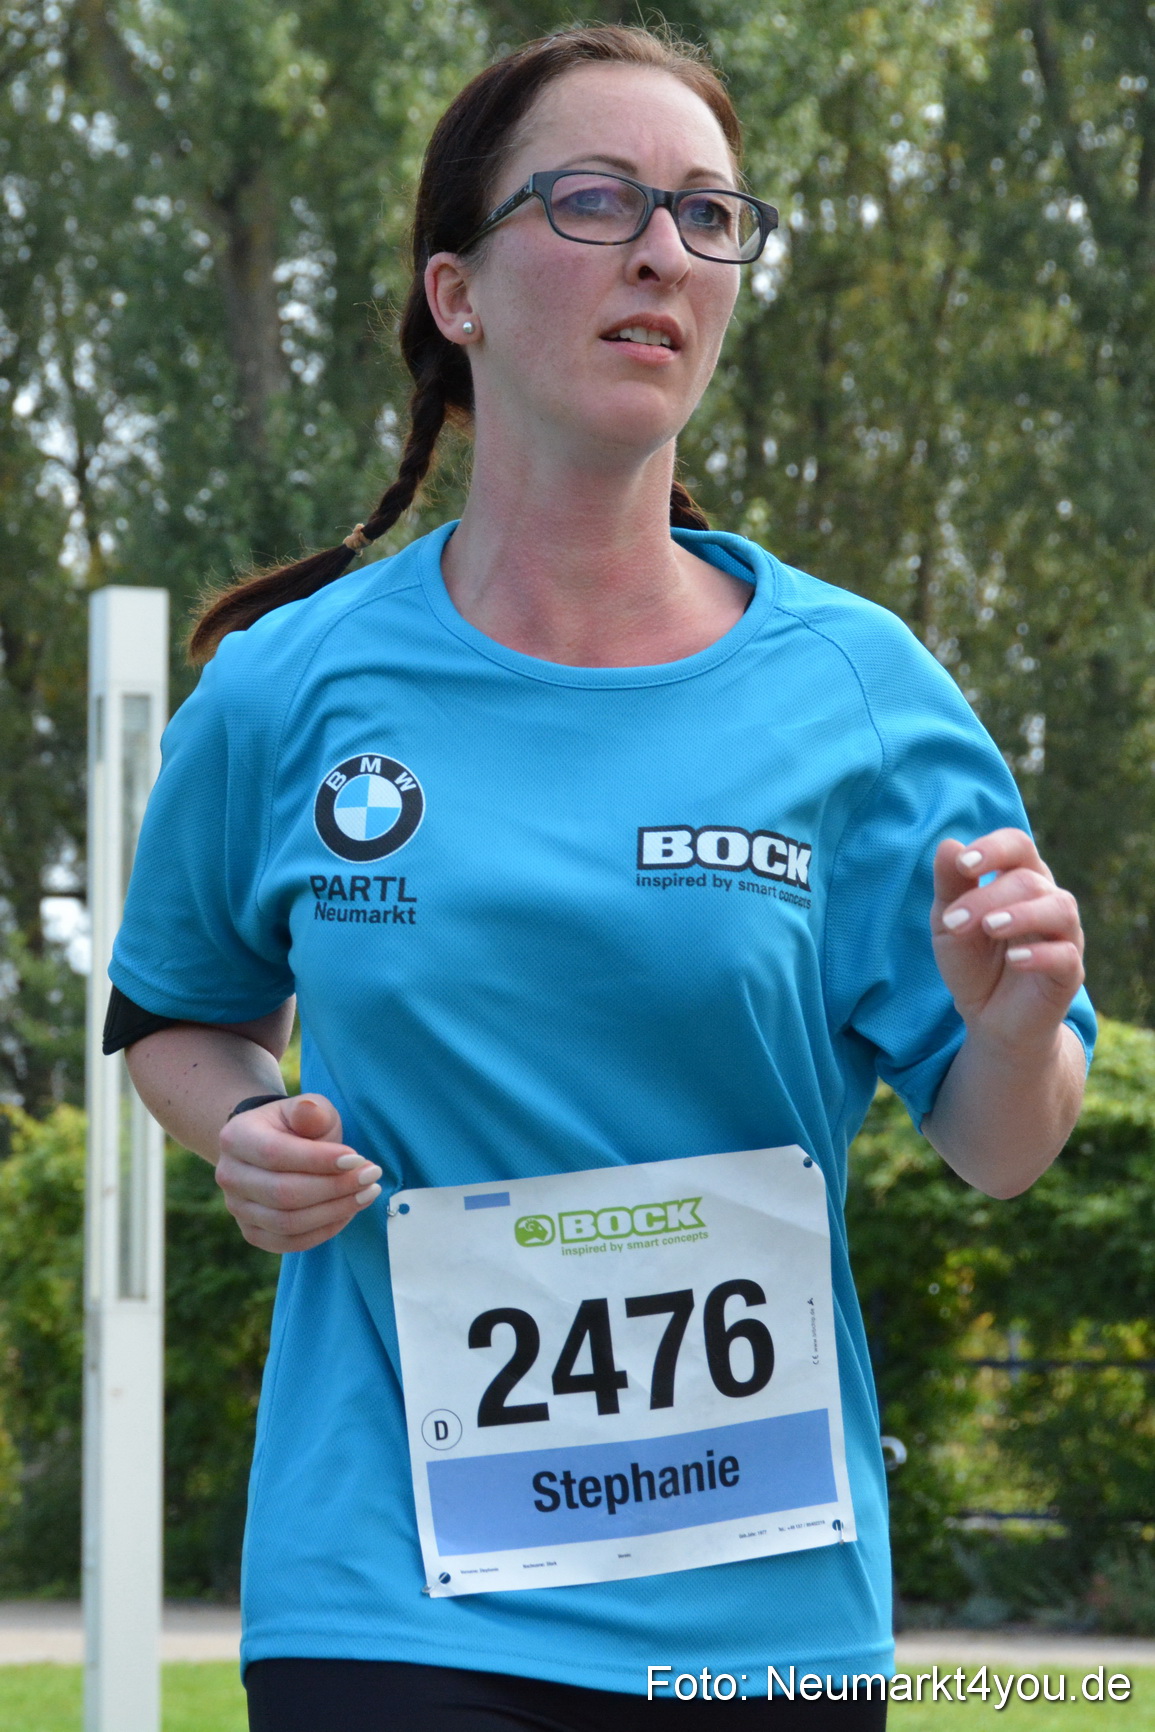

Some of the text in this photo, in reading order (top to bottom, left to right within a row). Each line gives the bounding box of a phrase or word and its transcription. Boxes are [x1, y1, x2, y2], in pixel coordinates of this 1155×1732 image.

[326, 757, 416, 791] BMW
[637, 825, 812, 892] BOCK
[310, 875, 417, 902] PARTL
[636, 872, 707, 890] inspired
[713, 875, 733, 892] by
[738, 880, 777, 898] smart
[315, 902, 416, 925] Neumarkt
[558, 1197, 706, 1244] BOCK
[561, 1231, 709, 1256] inspired by smart concepts
[467, 1278, 775, 1428] 2476
[434, 1420, 449, 1441] D
[532, 1450, 741, 1516] Stephanie
